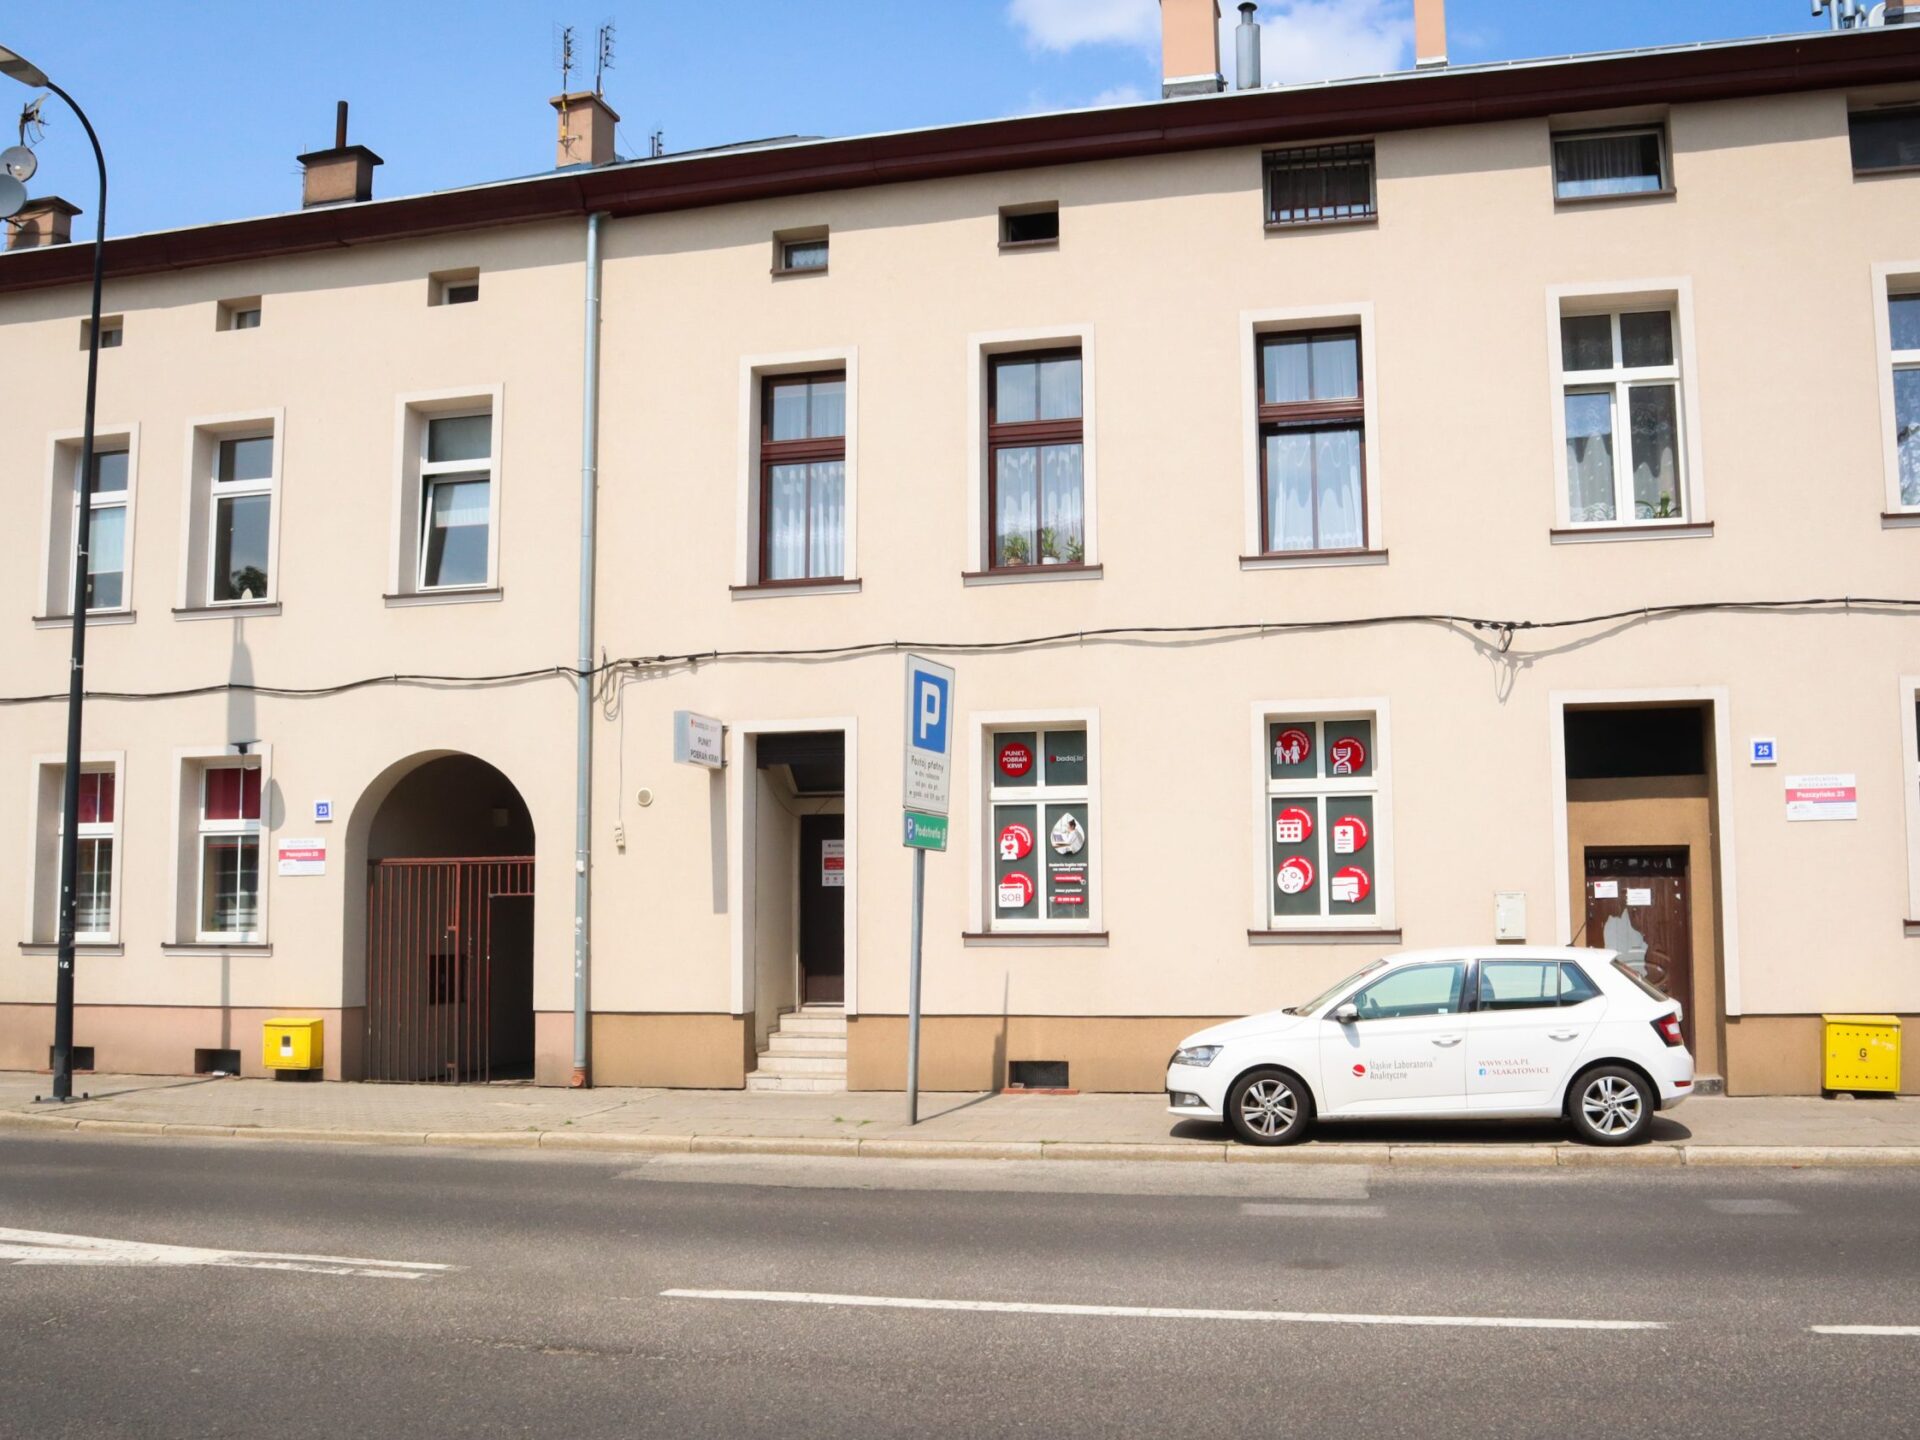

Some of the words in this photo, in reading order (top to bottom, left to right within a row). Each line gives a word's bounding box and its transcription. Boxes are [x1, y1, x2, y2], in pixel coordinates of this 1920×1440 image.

[920, 681, 941, 739] P
[1757, 745, 1770, 756] 25
[318, 805, 327, 814] 23
[1001, 893, 1022, 903] SOB
[1859, 1047, 1867, 1058] G
[1394, 1060, 1433, 1069] Laboratoria
[1370, 1071, 1408, 1081] Analityczne
